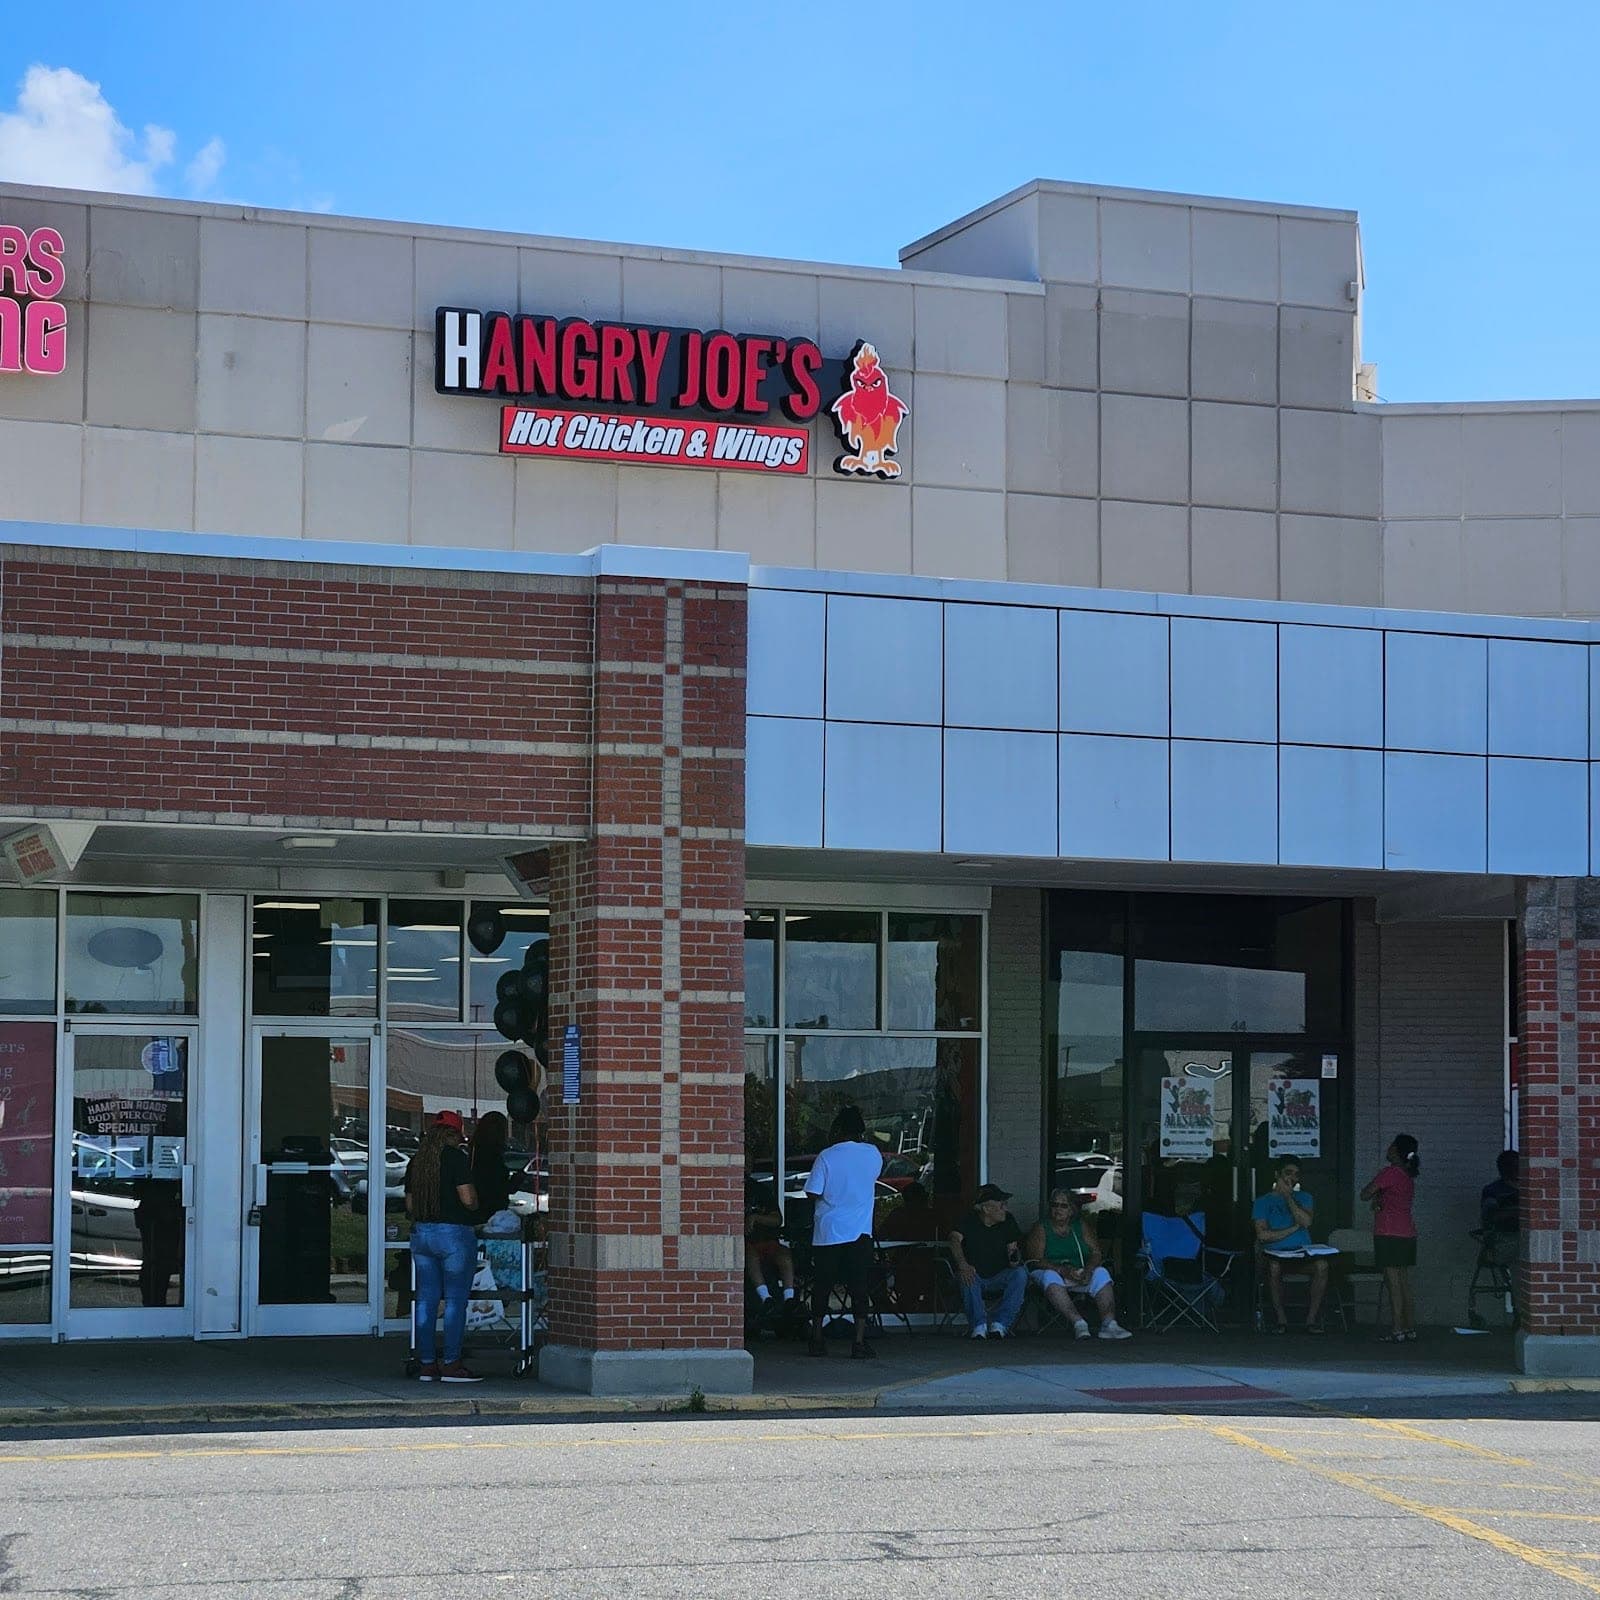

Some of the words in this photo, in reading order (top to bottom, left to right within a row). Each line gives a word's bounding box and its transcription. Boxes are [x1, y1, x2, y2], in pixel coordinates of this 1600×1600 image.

[444, 311, 670, 403] HANGRY
[679, 332, 823, 418] JOE'S
[507, 411, 563, 446] Hot
[563, 415, 685, 455] Chicken
[686, 429, 708, 457] &
[712, 426, 804, 467] Wings
[1230, 1020, 1247, 1032] 44
[88, 1101, 133, 1115] HAMPTON
[136, 1101, 168, 1113] ROADS
[87, 1110, 117, 1124] BODY
[119, 1110, 167, 1122] PIERCING
[98, 1122, 157, 1134] SPECIALIST
